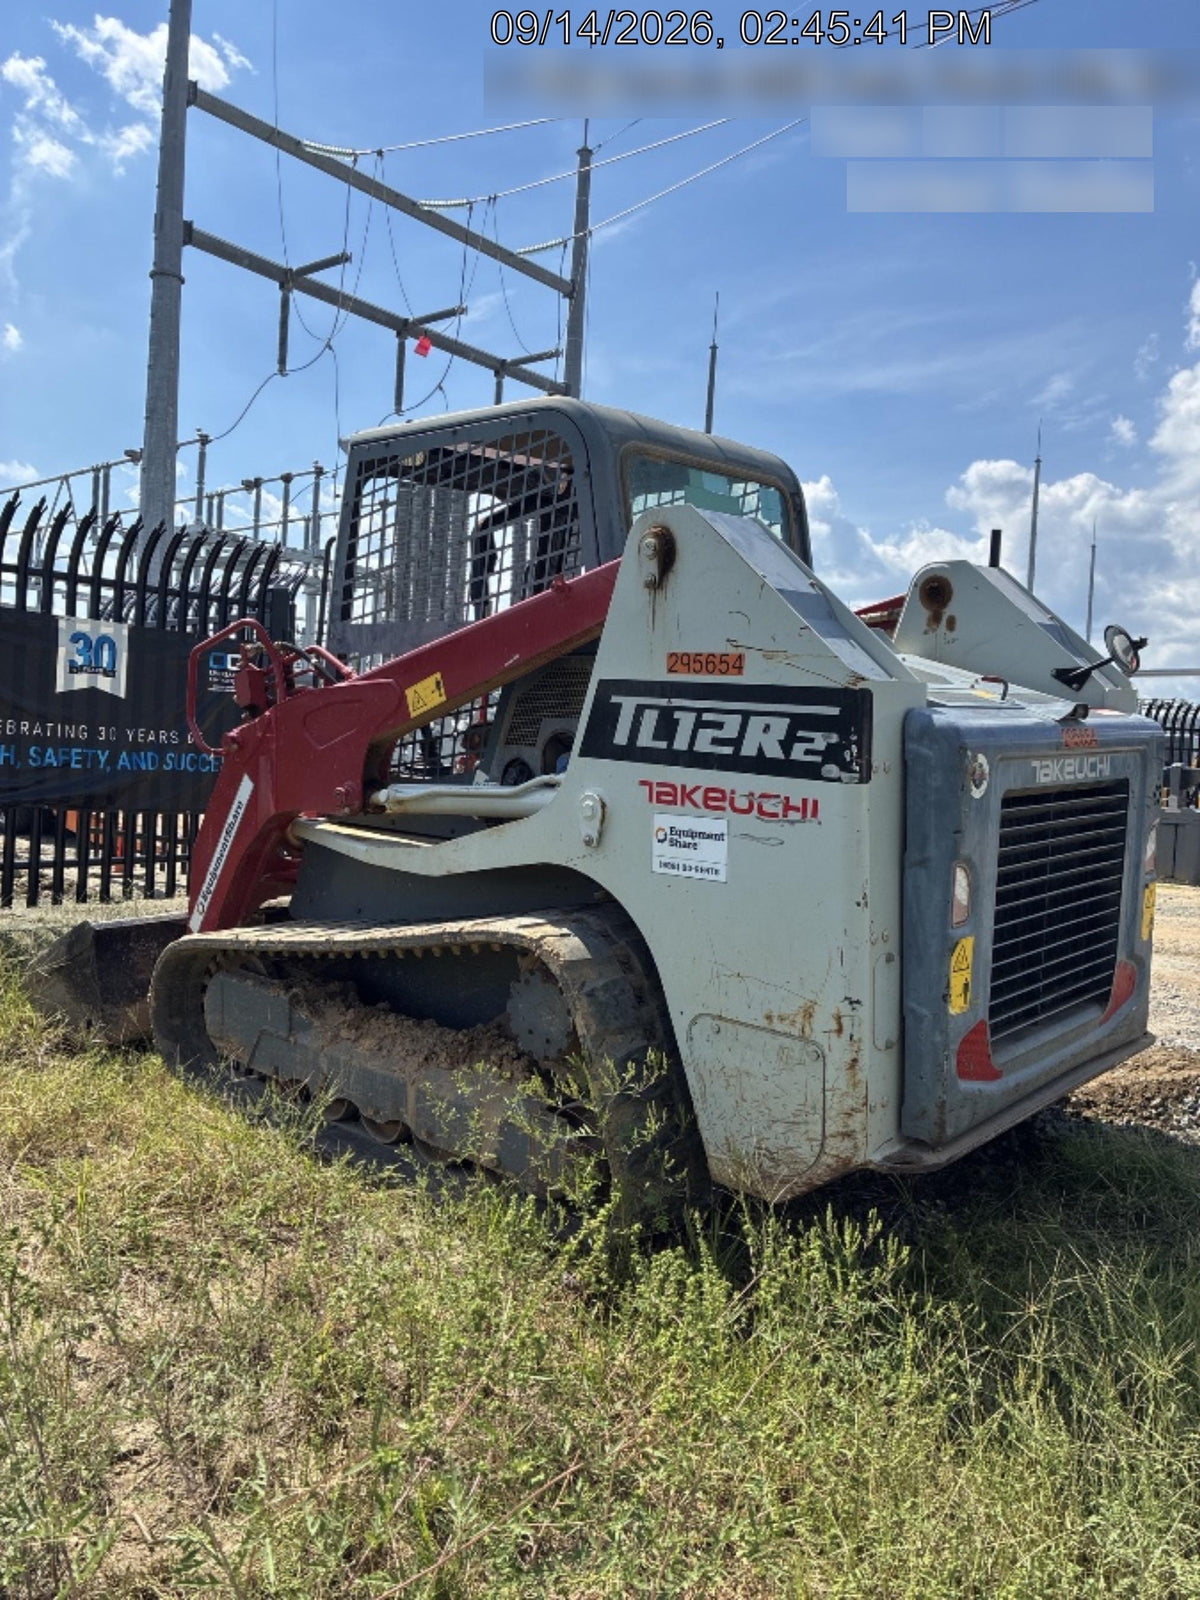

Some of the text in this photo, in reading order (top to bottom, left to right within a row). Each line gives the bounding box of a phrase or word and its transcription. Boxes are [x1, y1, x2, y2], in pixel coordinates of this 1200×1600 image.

[68, 631, 116, 672] 30
[668, 653, 744, 673] 295654
[126, 728, 180, 744] YEARS
[28, 745, 111, 773] SAFETY,
[117, 751, 159, 770] AND
[163, 752, 224, 772] SUCCE
[669, 826, 725, 842] Equipment
[668, 837, 698, 850] Share
